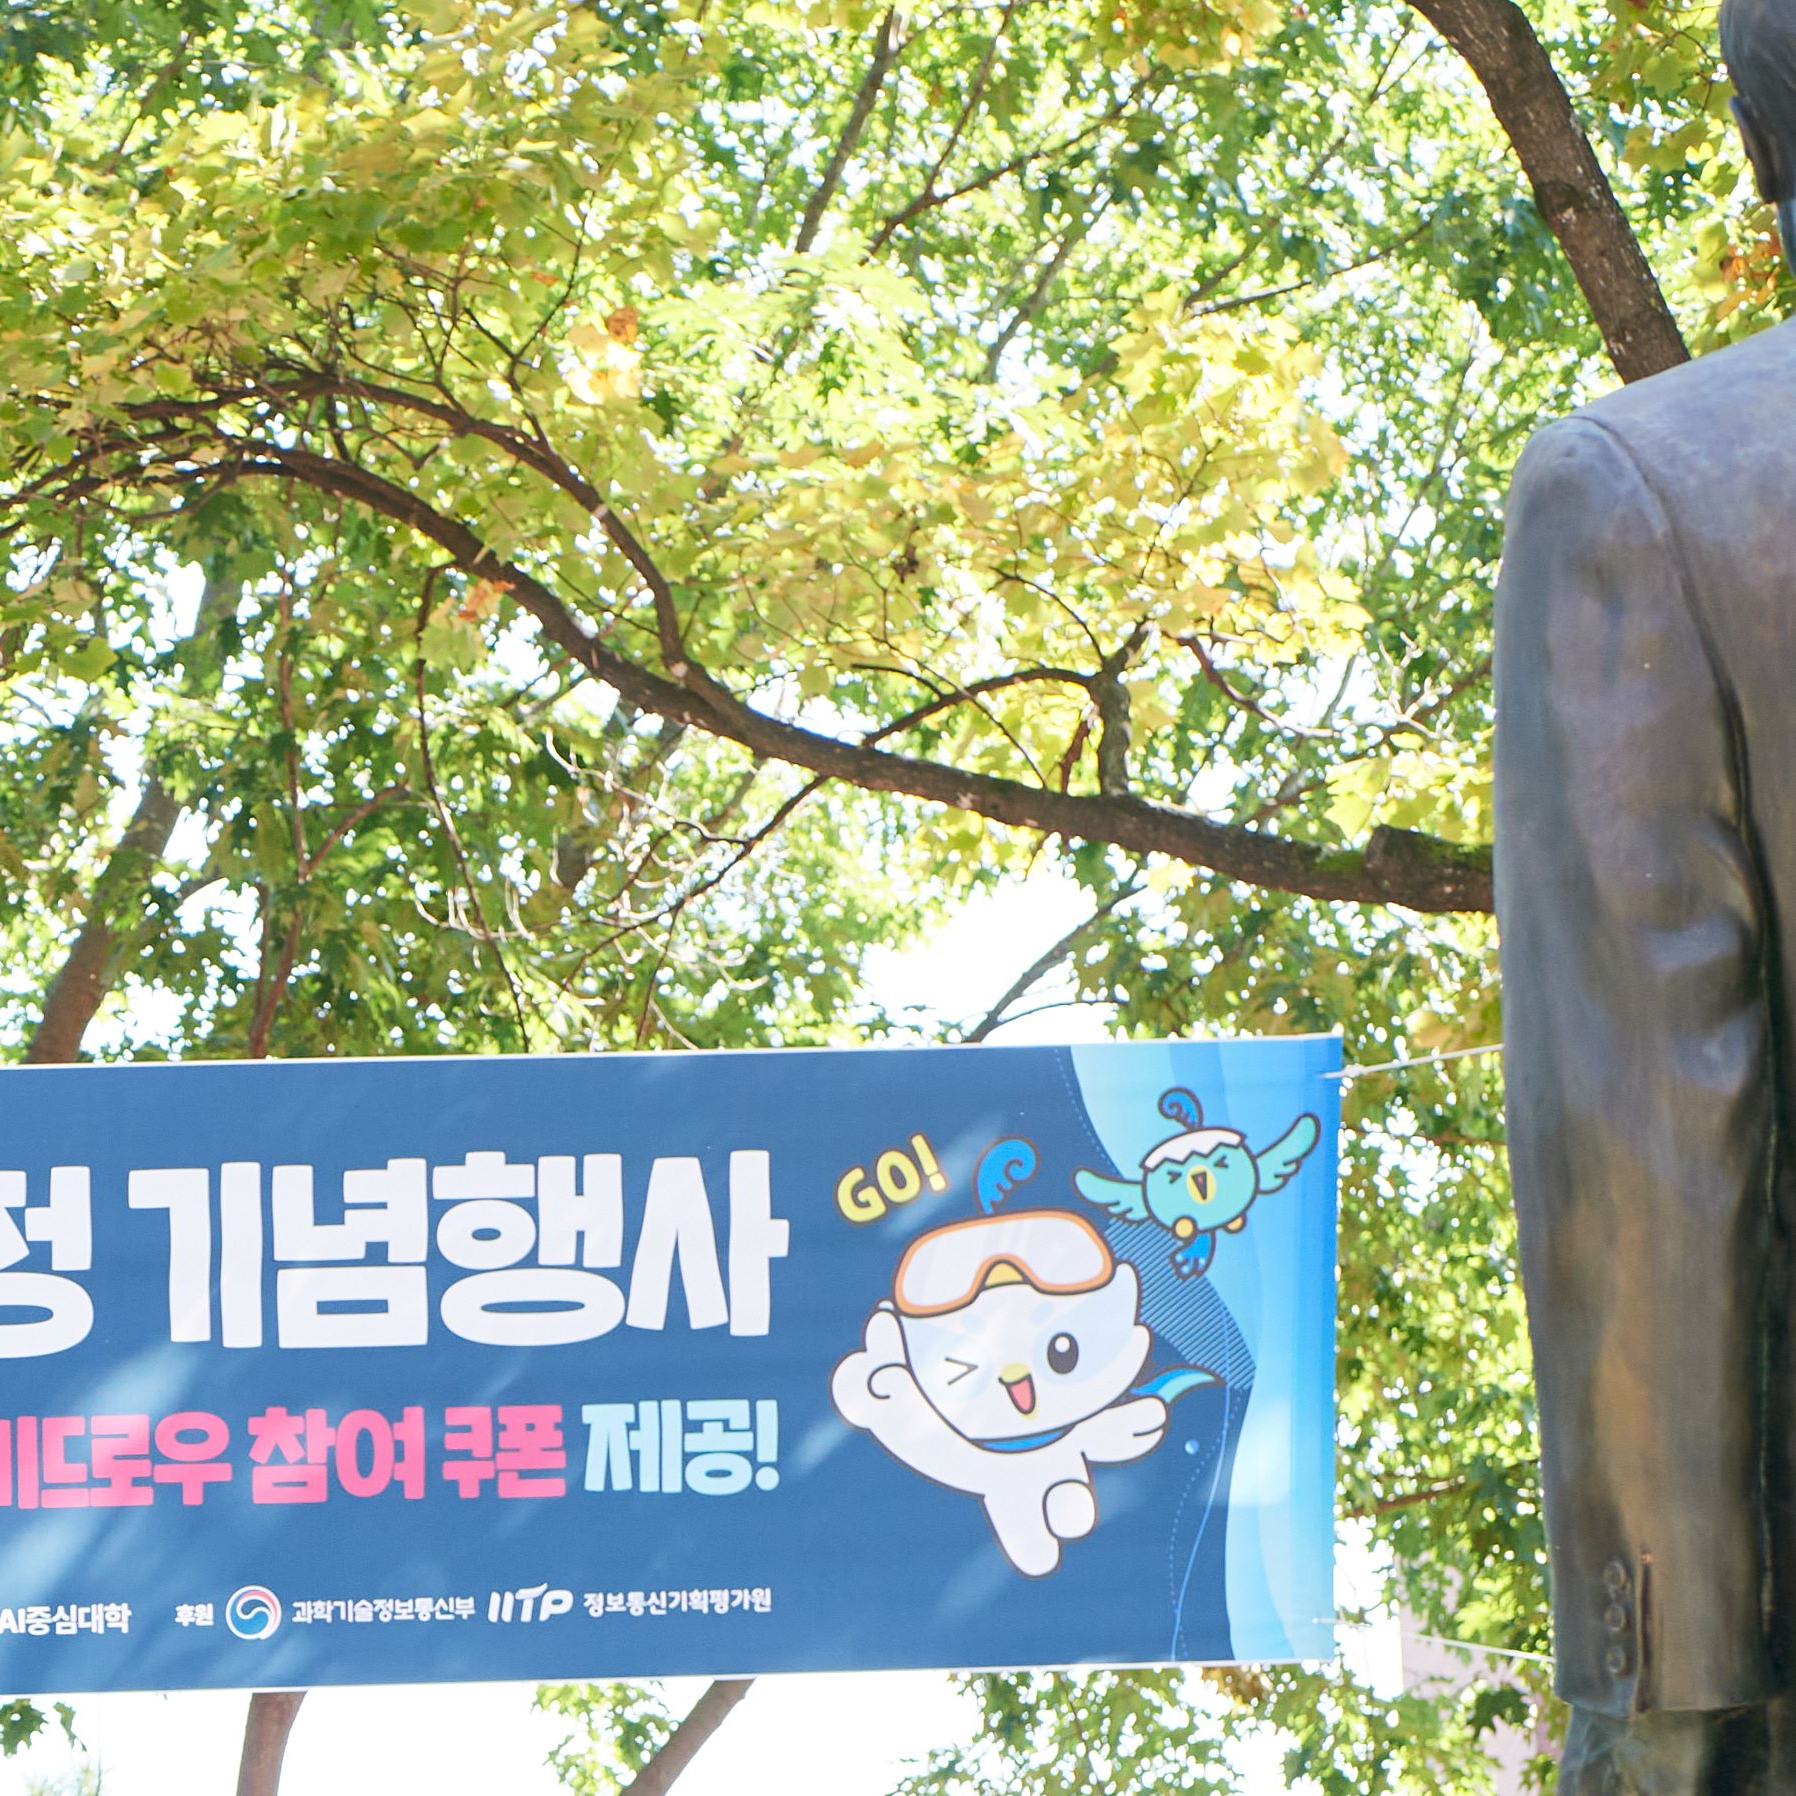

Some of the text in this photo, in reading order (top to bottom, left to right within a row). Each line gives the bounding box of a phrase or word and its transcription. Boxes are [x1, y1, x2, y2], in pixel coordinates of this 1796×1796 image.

[835, 1135, 948, 1225] GO!
[130, 1148, 789, 1345] 기념행사
[246, 1405, 424, 1506] 참여
[443, 1401, 567, 1500] 쿠폰
[582, 1397, 779, 1493] 제공!
[175, 1604, 213, 1625] 후원
[291, 1597, 475, 1624] 과학기술정보통신부
[584, 1588, 771, 1616] 정보통신기획평가원
